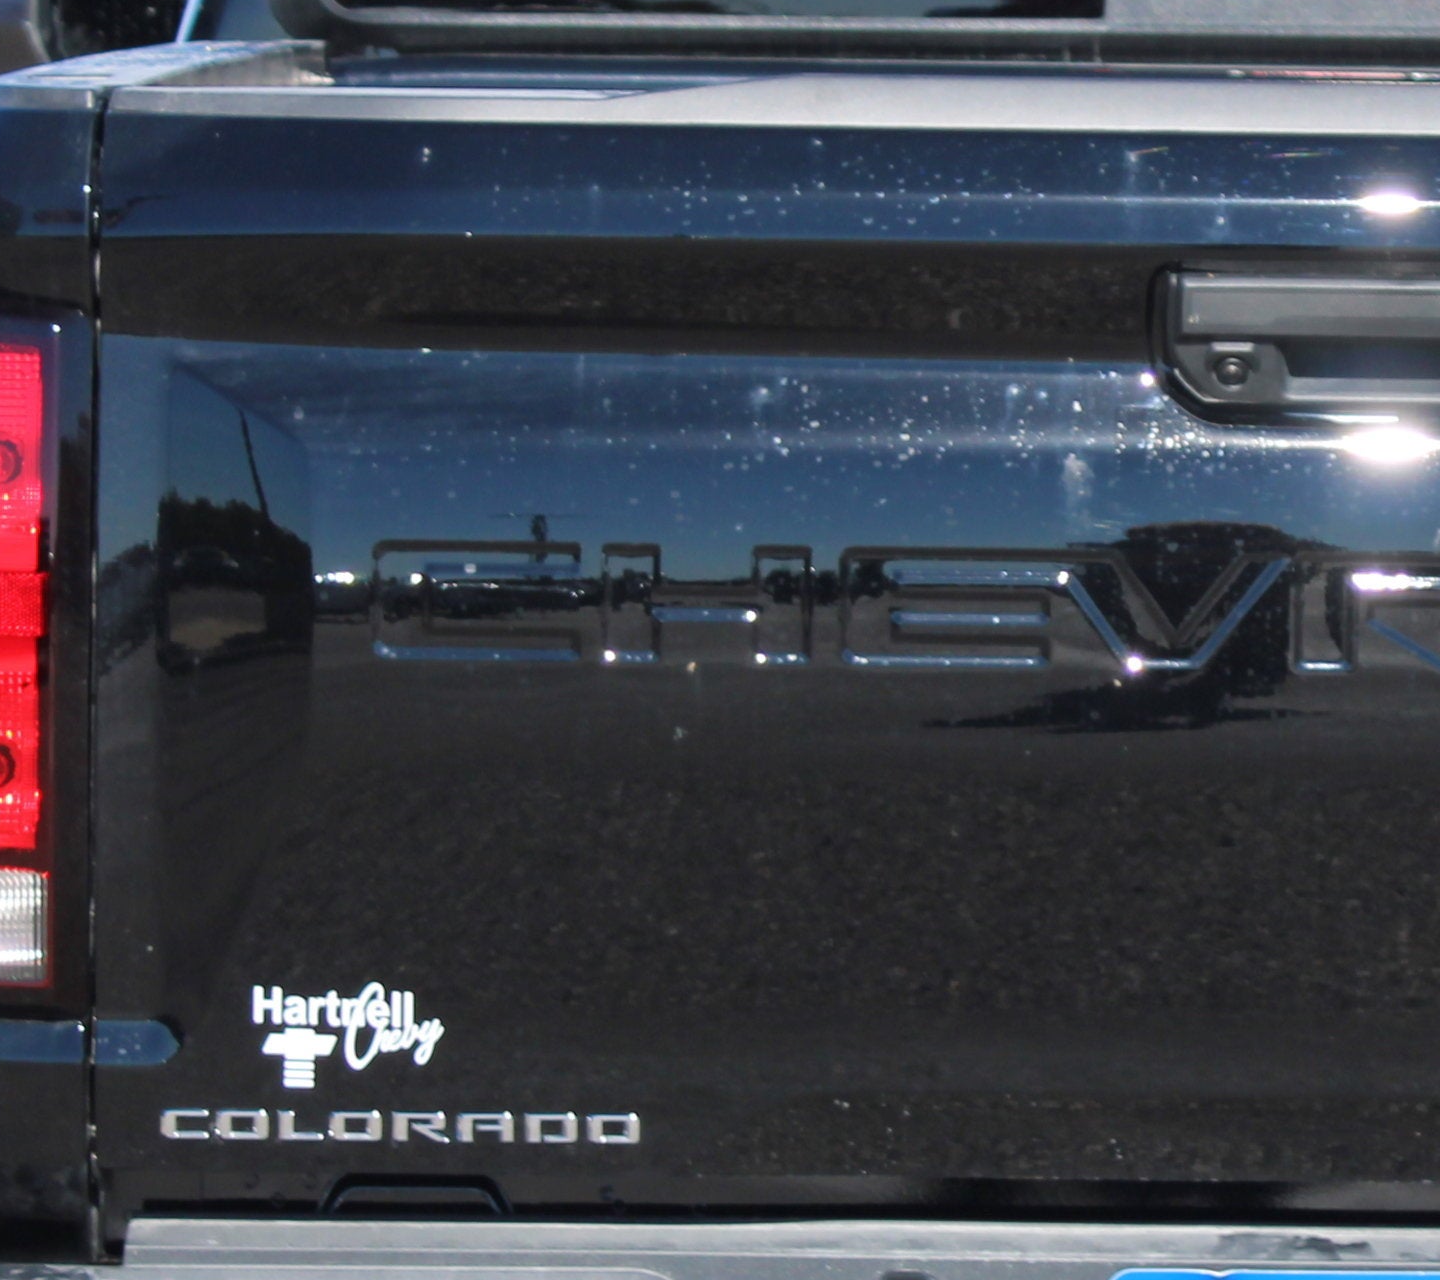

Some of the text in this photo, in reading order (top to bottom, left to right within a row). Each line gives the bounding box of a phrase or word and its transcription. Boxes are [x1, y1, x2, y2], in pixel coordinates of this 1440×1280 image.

[251, 984, 415, 1030] Hartnell
[343, 980, 446, 1071] Chevy
[159, 1107, 642, 1144] COLORADO
